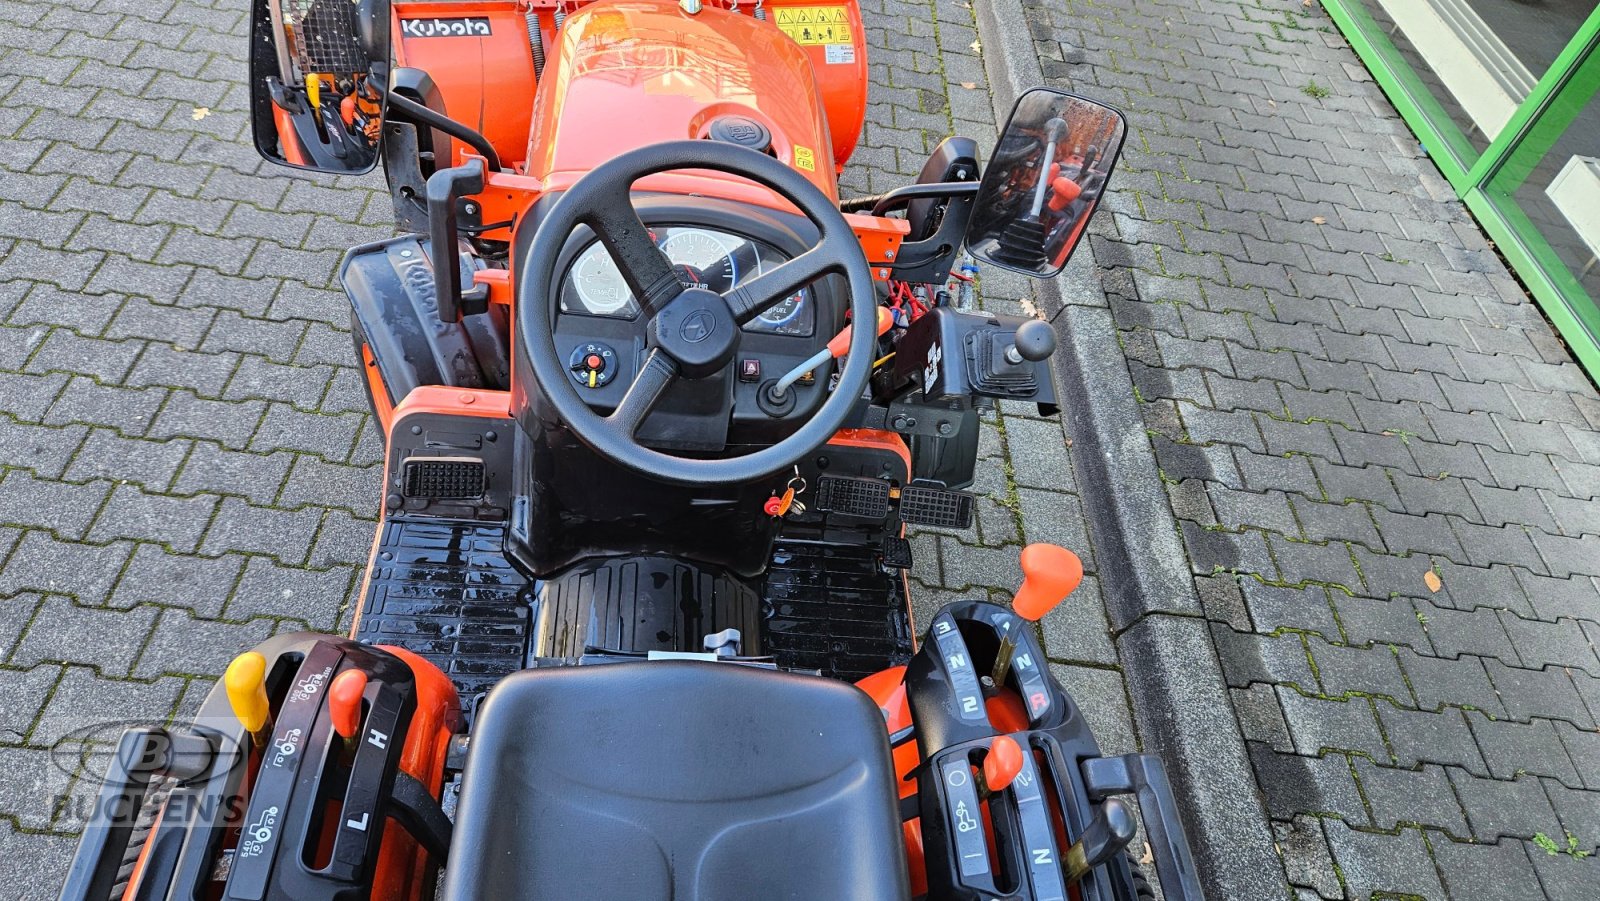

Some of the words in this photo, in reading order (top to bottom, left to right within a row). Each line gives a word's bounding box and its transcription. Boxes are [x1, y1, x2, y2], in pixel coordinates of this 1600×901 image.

[402, 18, 489, 37] Kubota
[785, 297, 793, 306] E
[935, 620, 951, 634] 3
[950, 654, 966, 669] N
[1016, 653, 1032, 670] N
[962, 697, 978, 713] 2
[1030, 693, 1048, 712] R
[368, 728, 388, 750] H
[346, 812, 370, 831] L
[240, 840, 252, 858] 540
[1033, 848, 1052, 864] N
